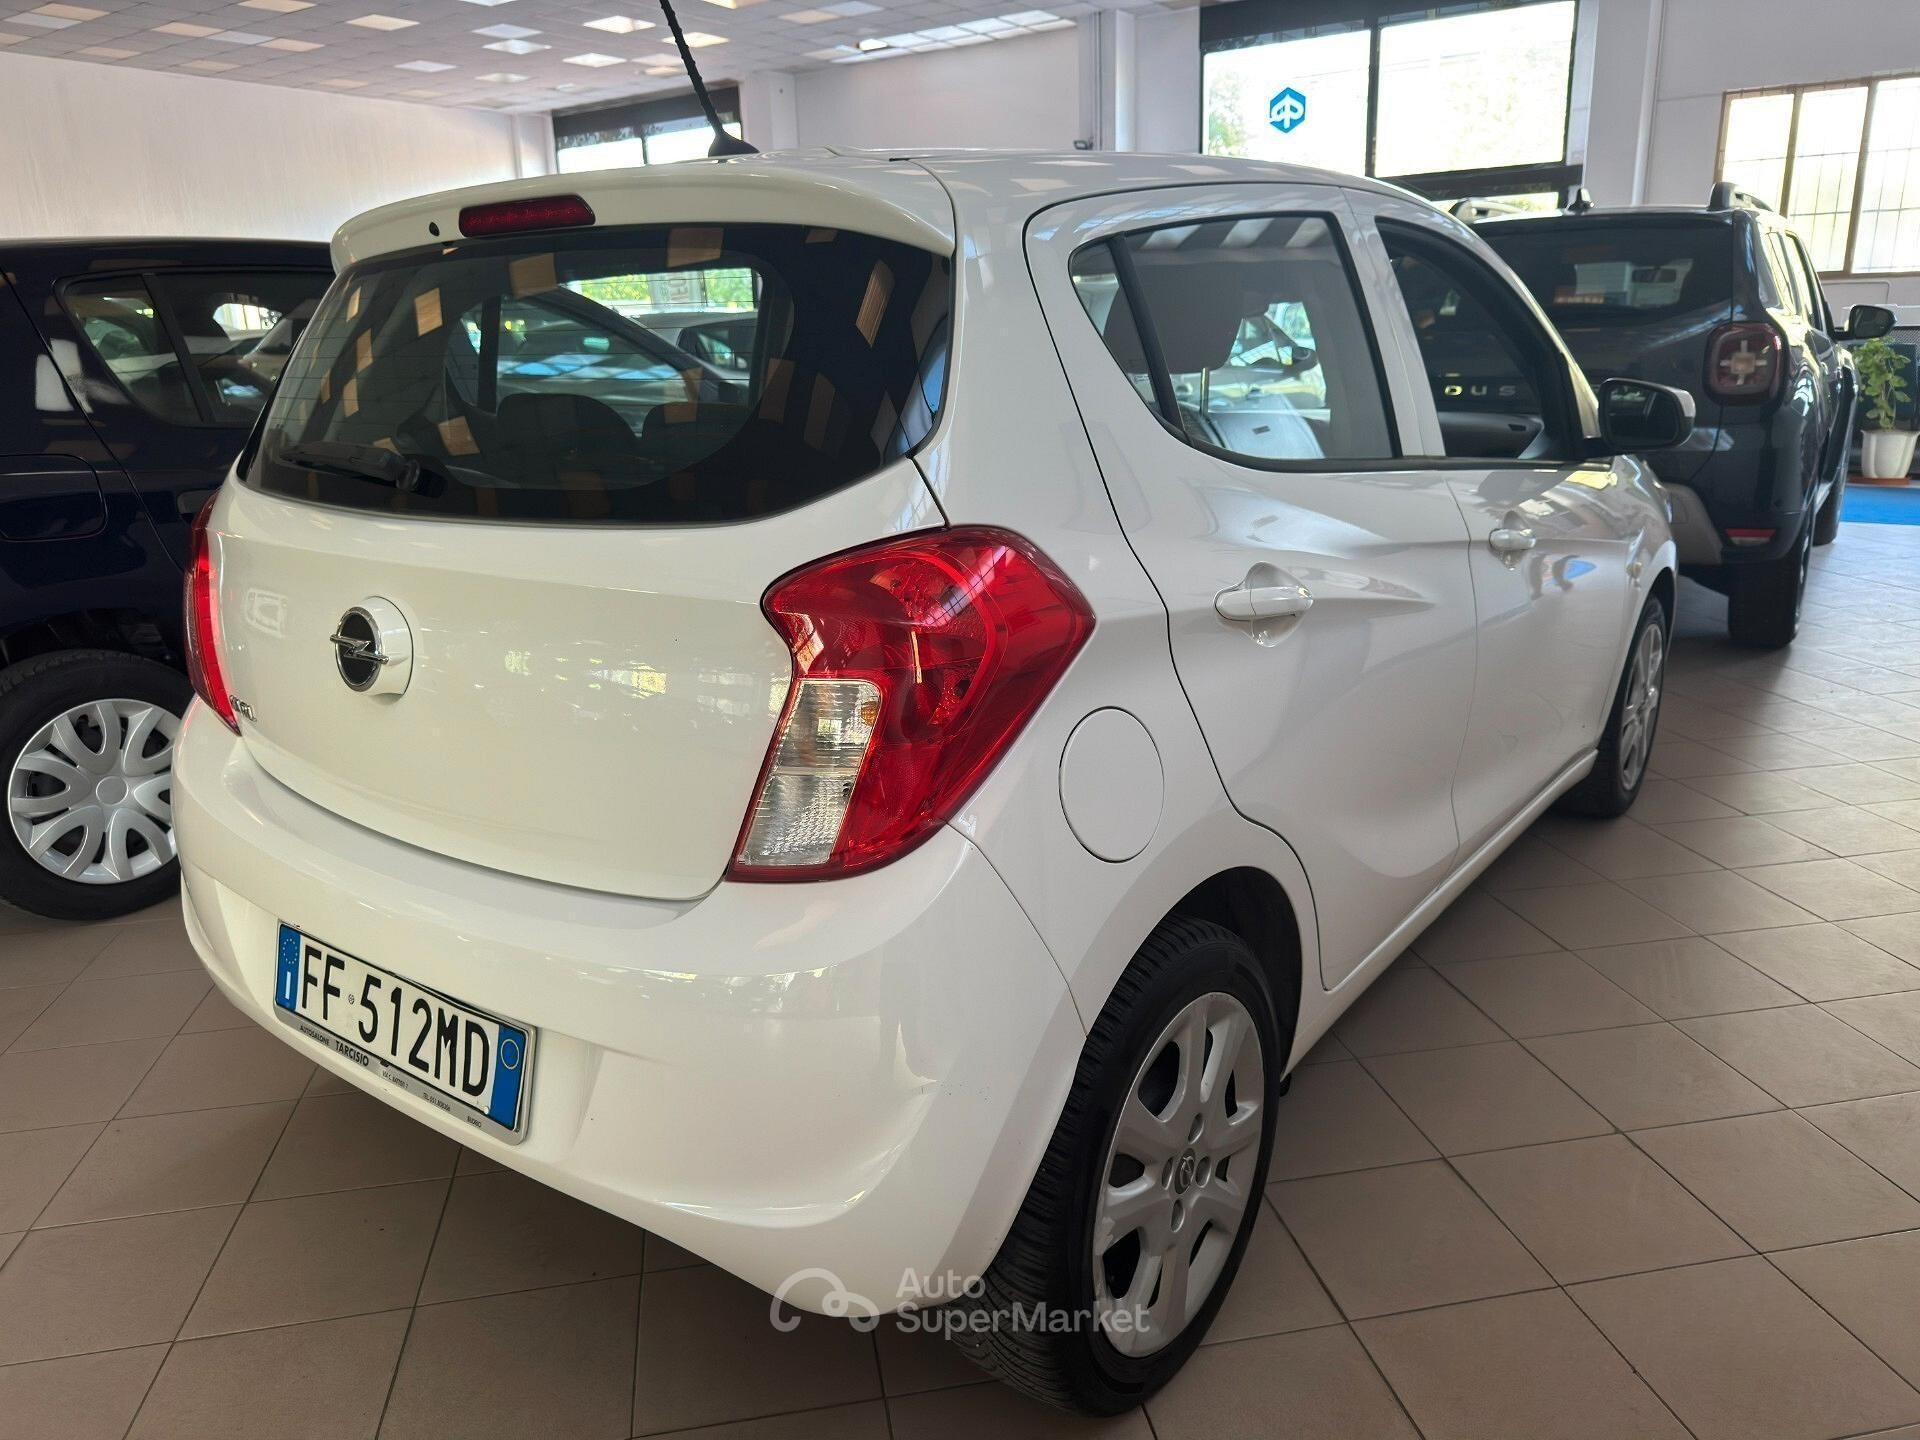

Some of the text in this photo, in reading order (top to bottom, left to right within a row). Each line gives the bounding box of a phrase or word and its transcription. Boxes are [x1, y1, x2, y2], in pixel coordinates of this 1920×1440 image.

[1444, 385, 1516, 397] DUS
[301, 944, 490, 1097] FF 512MD
[335, 1040, 369, 1067] TARCISIO
